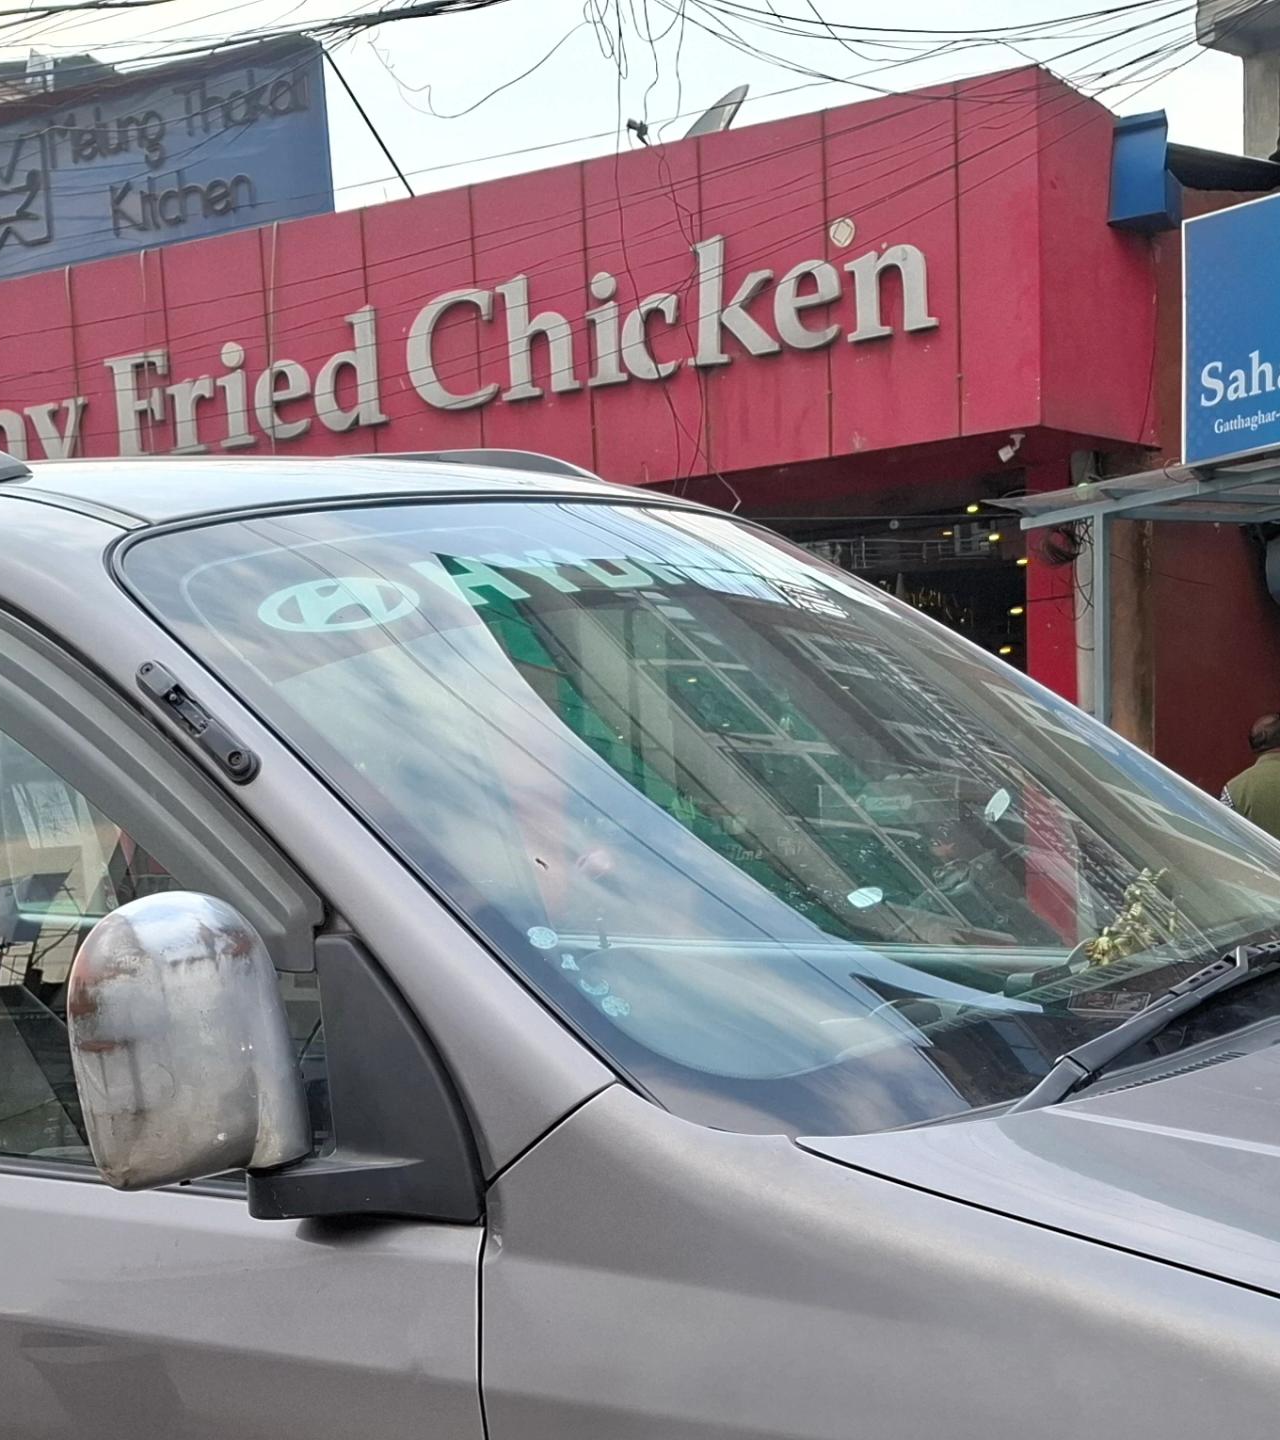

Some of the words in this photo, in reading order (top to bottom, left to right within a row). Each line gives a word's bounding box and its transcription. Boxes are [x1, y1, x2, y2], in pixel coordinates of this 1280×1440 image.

[109, 169, 257, 237] Kitchen
[104, 305, 387, 456] Fried
[406, 234, 940, 411] Chicken
